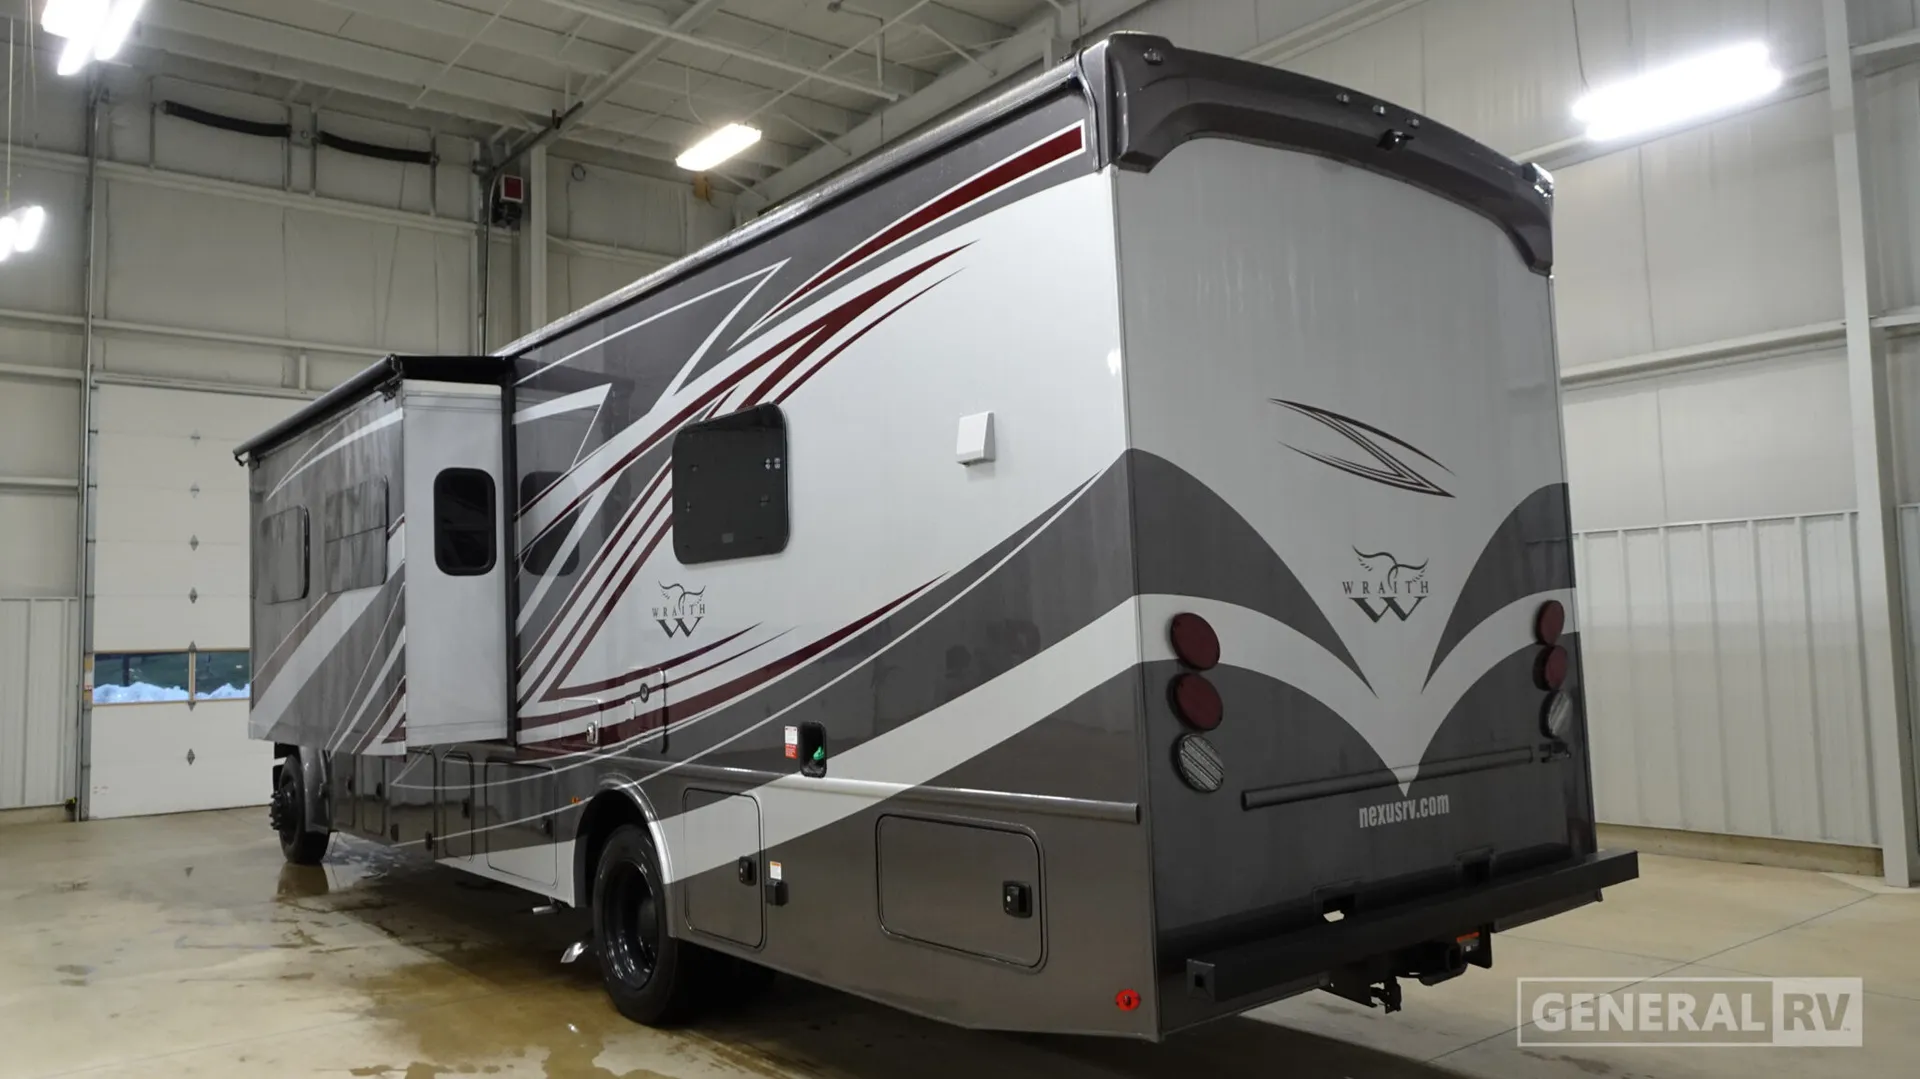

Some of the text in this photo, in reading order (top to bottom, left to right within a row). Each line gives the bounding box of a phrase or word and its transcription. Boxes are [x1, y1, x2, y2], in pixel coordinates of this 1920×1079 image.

[1342, 580, 1429, 595] WRAITH
[651, 603, 705, 618] WRAITH
[1359, 794, 1450, 828] nexusrv.com
